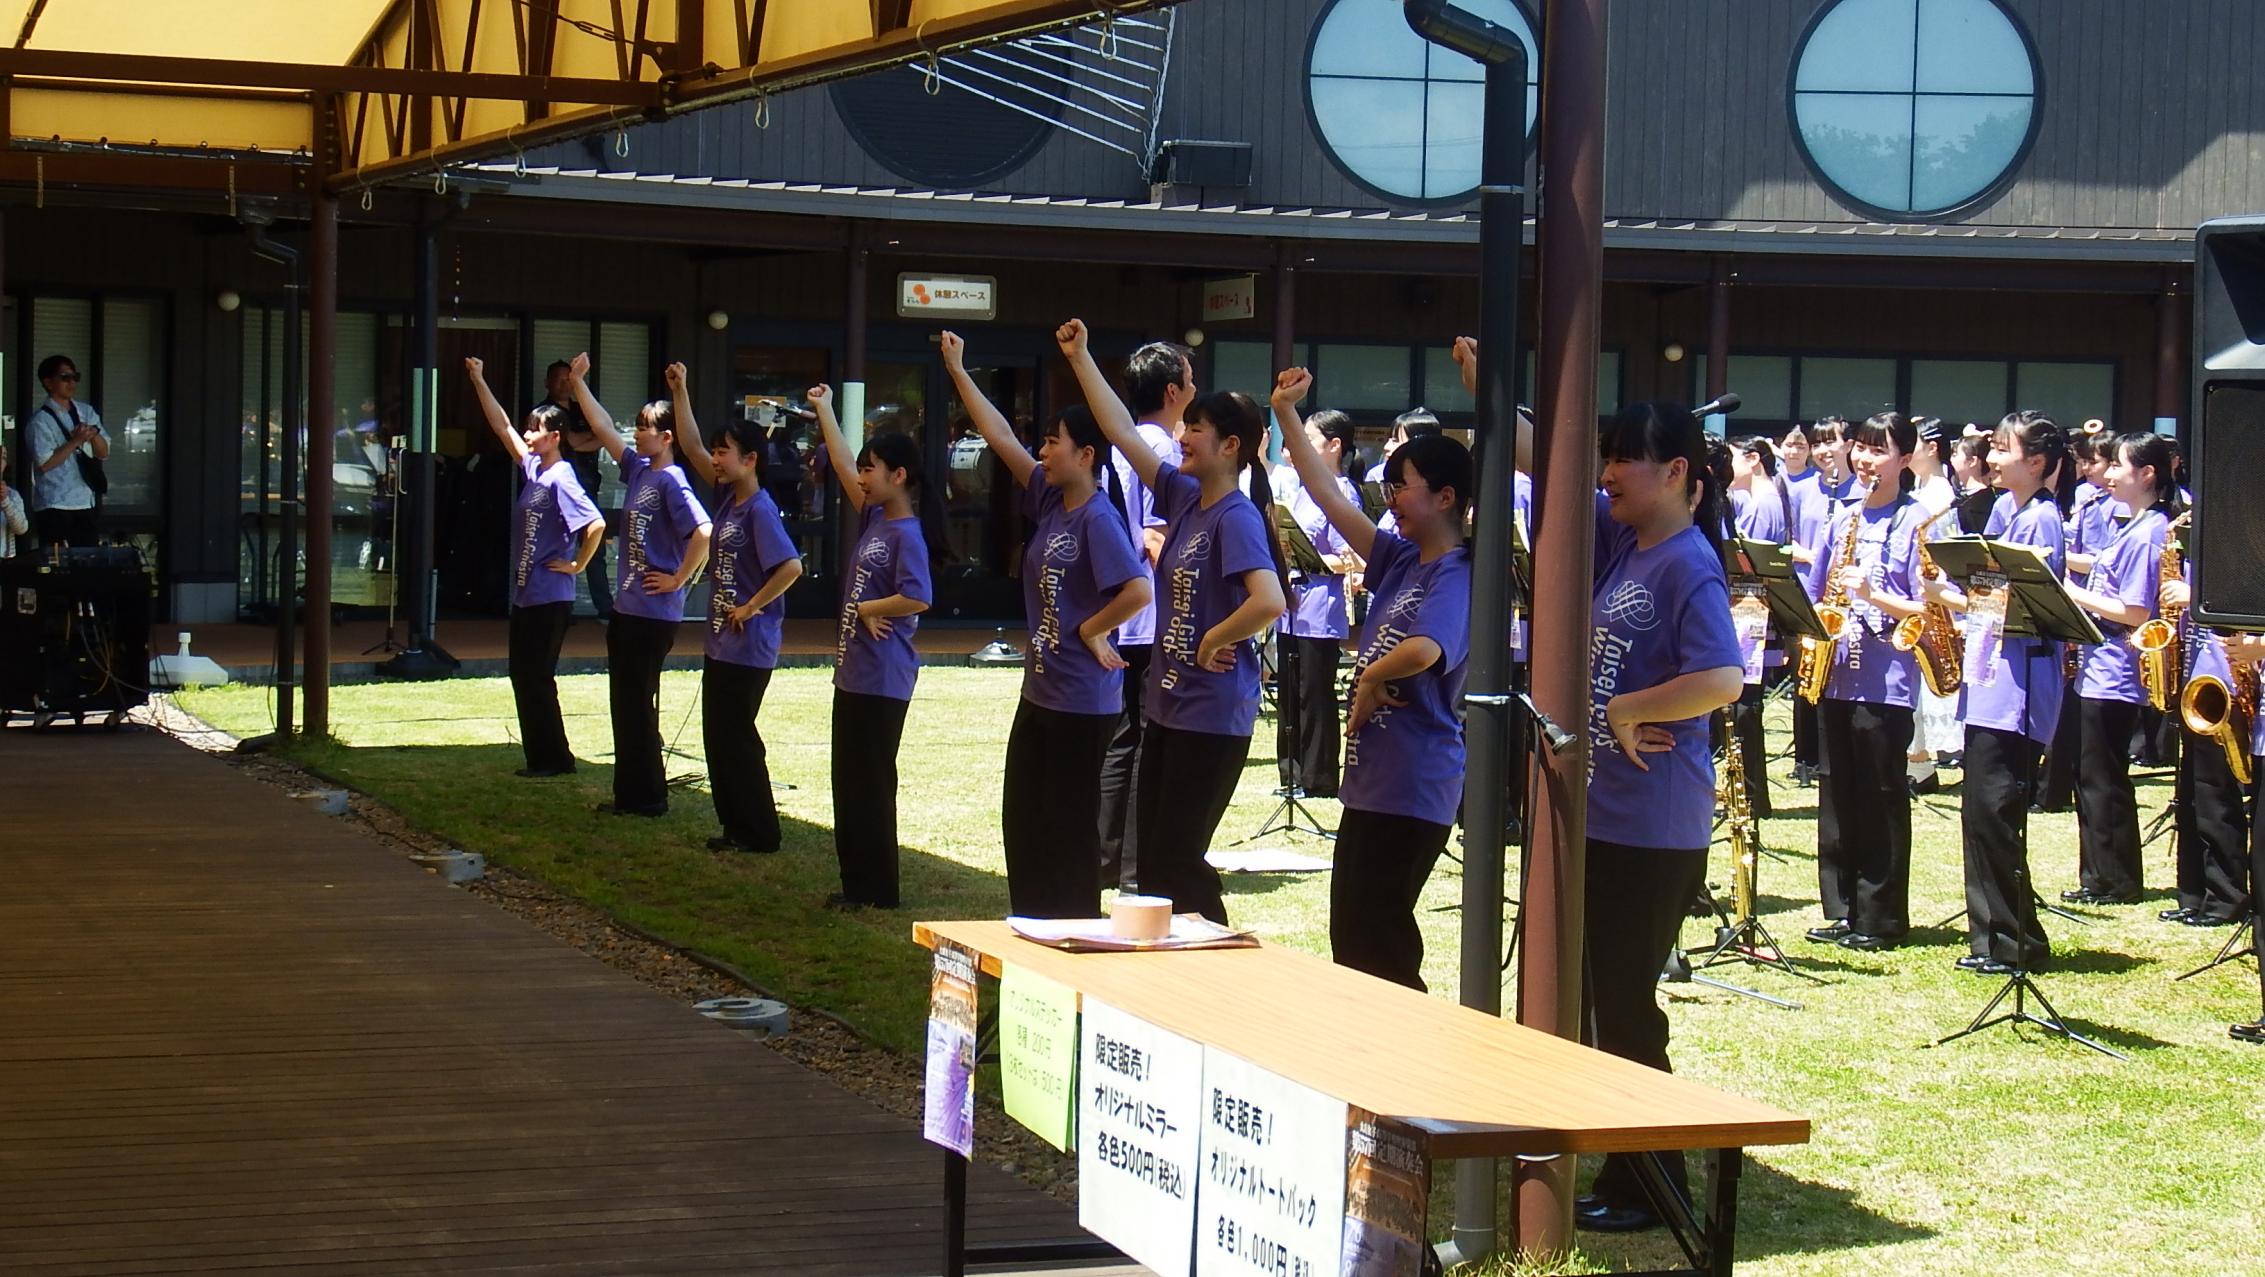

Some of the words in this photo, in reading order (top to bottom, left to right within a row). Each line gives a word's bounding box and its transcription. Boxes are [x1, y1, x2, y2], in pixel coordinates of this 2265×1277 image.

[851, 565, 872, 602] Taise
[1173, 567, 1186, 611] Wind
[1181, 568, 1200, 619] Taisei
[1176, 623, 1196, 667] Girls'
[1358, 623, 1390, 668] Wind
[1595, 634, 1633, 697] Taisei
[2183, 621, 2198, 678] rchestra
[1095, 1033, 1151, 1082] 限定販売！
[1095, 1083, 1178, 1139] オリジナルミラー
[1212, 1087, 1273, 1146] 限定販売！
[1098, 1130, 1187, 1201] 各色500円(税込)
